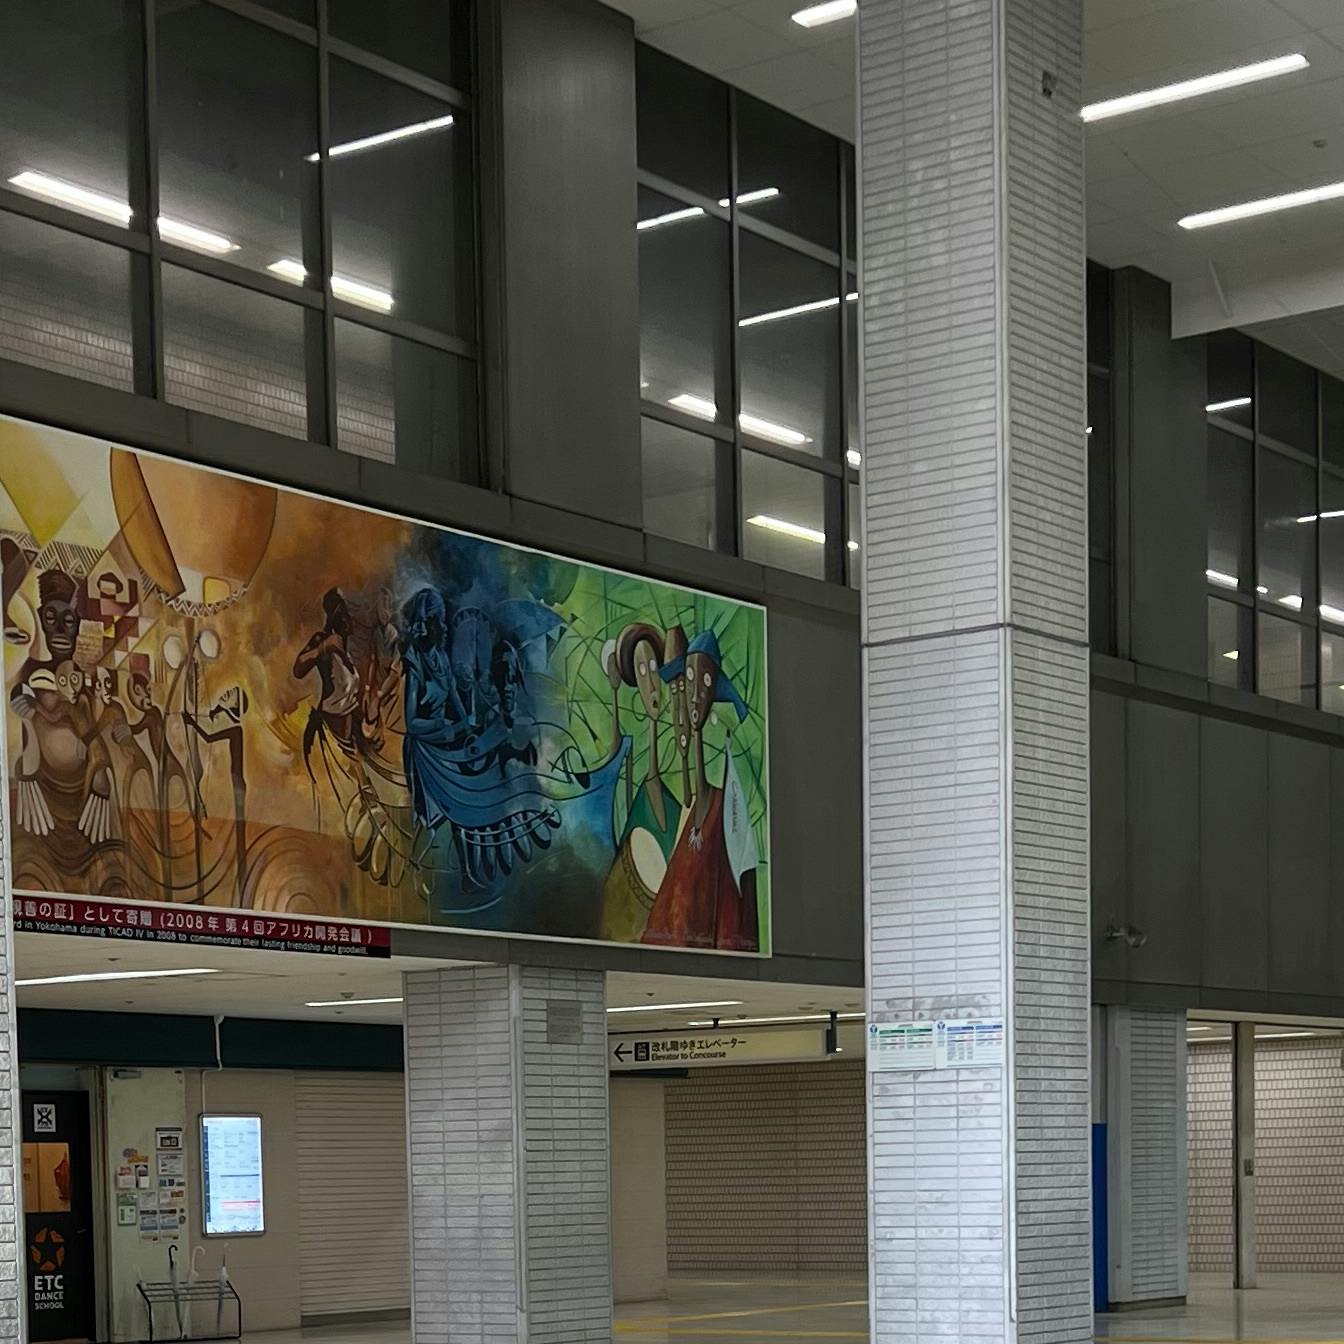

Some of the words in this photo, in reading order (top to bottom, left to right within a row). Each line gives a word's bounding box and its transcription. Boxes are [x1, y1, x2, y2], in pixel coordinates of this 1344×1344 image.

[35, 921, 78, 933] Yokohama
[80, 924, 106, 937] during
[107, 926, 134, 937] TICAD
[156, 930, 177, 941] 2008
[323, 944, 336, 953] and
[689, 1051, 727, 1060] Concourse
[34, 1274, 64, 1291] ETC
[34, 1291, 64, 1301] DANCE
[34, 1301, 65, 1310] SCHOOL
